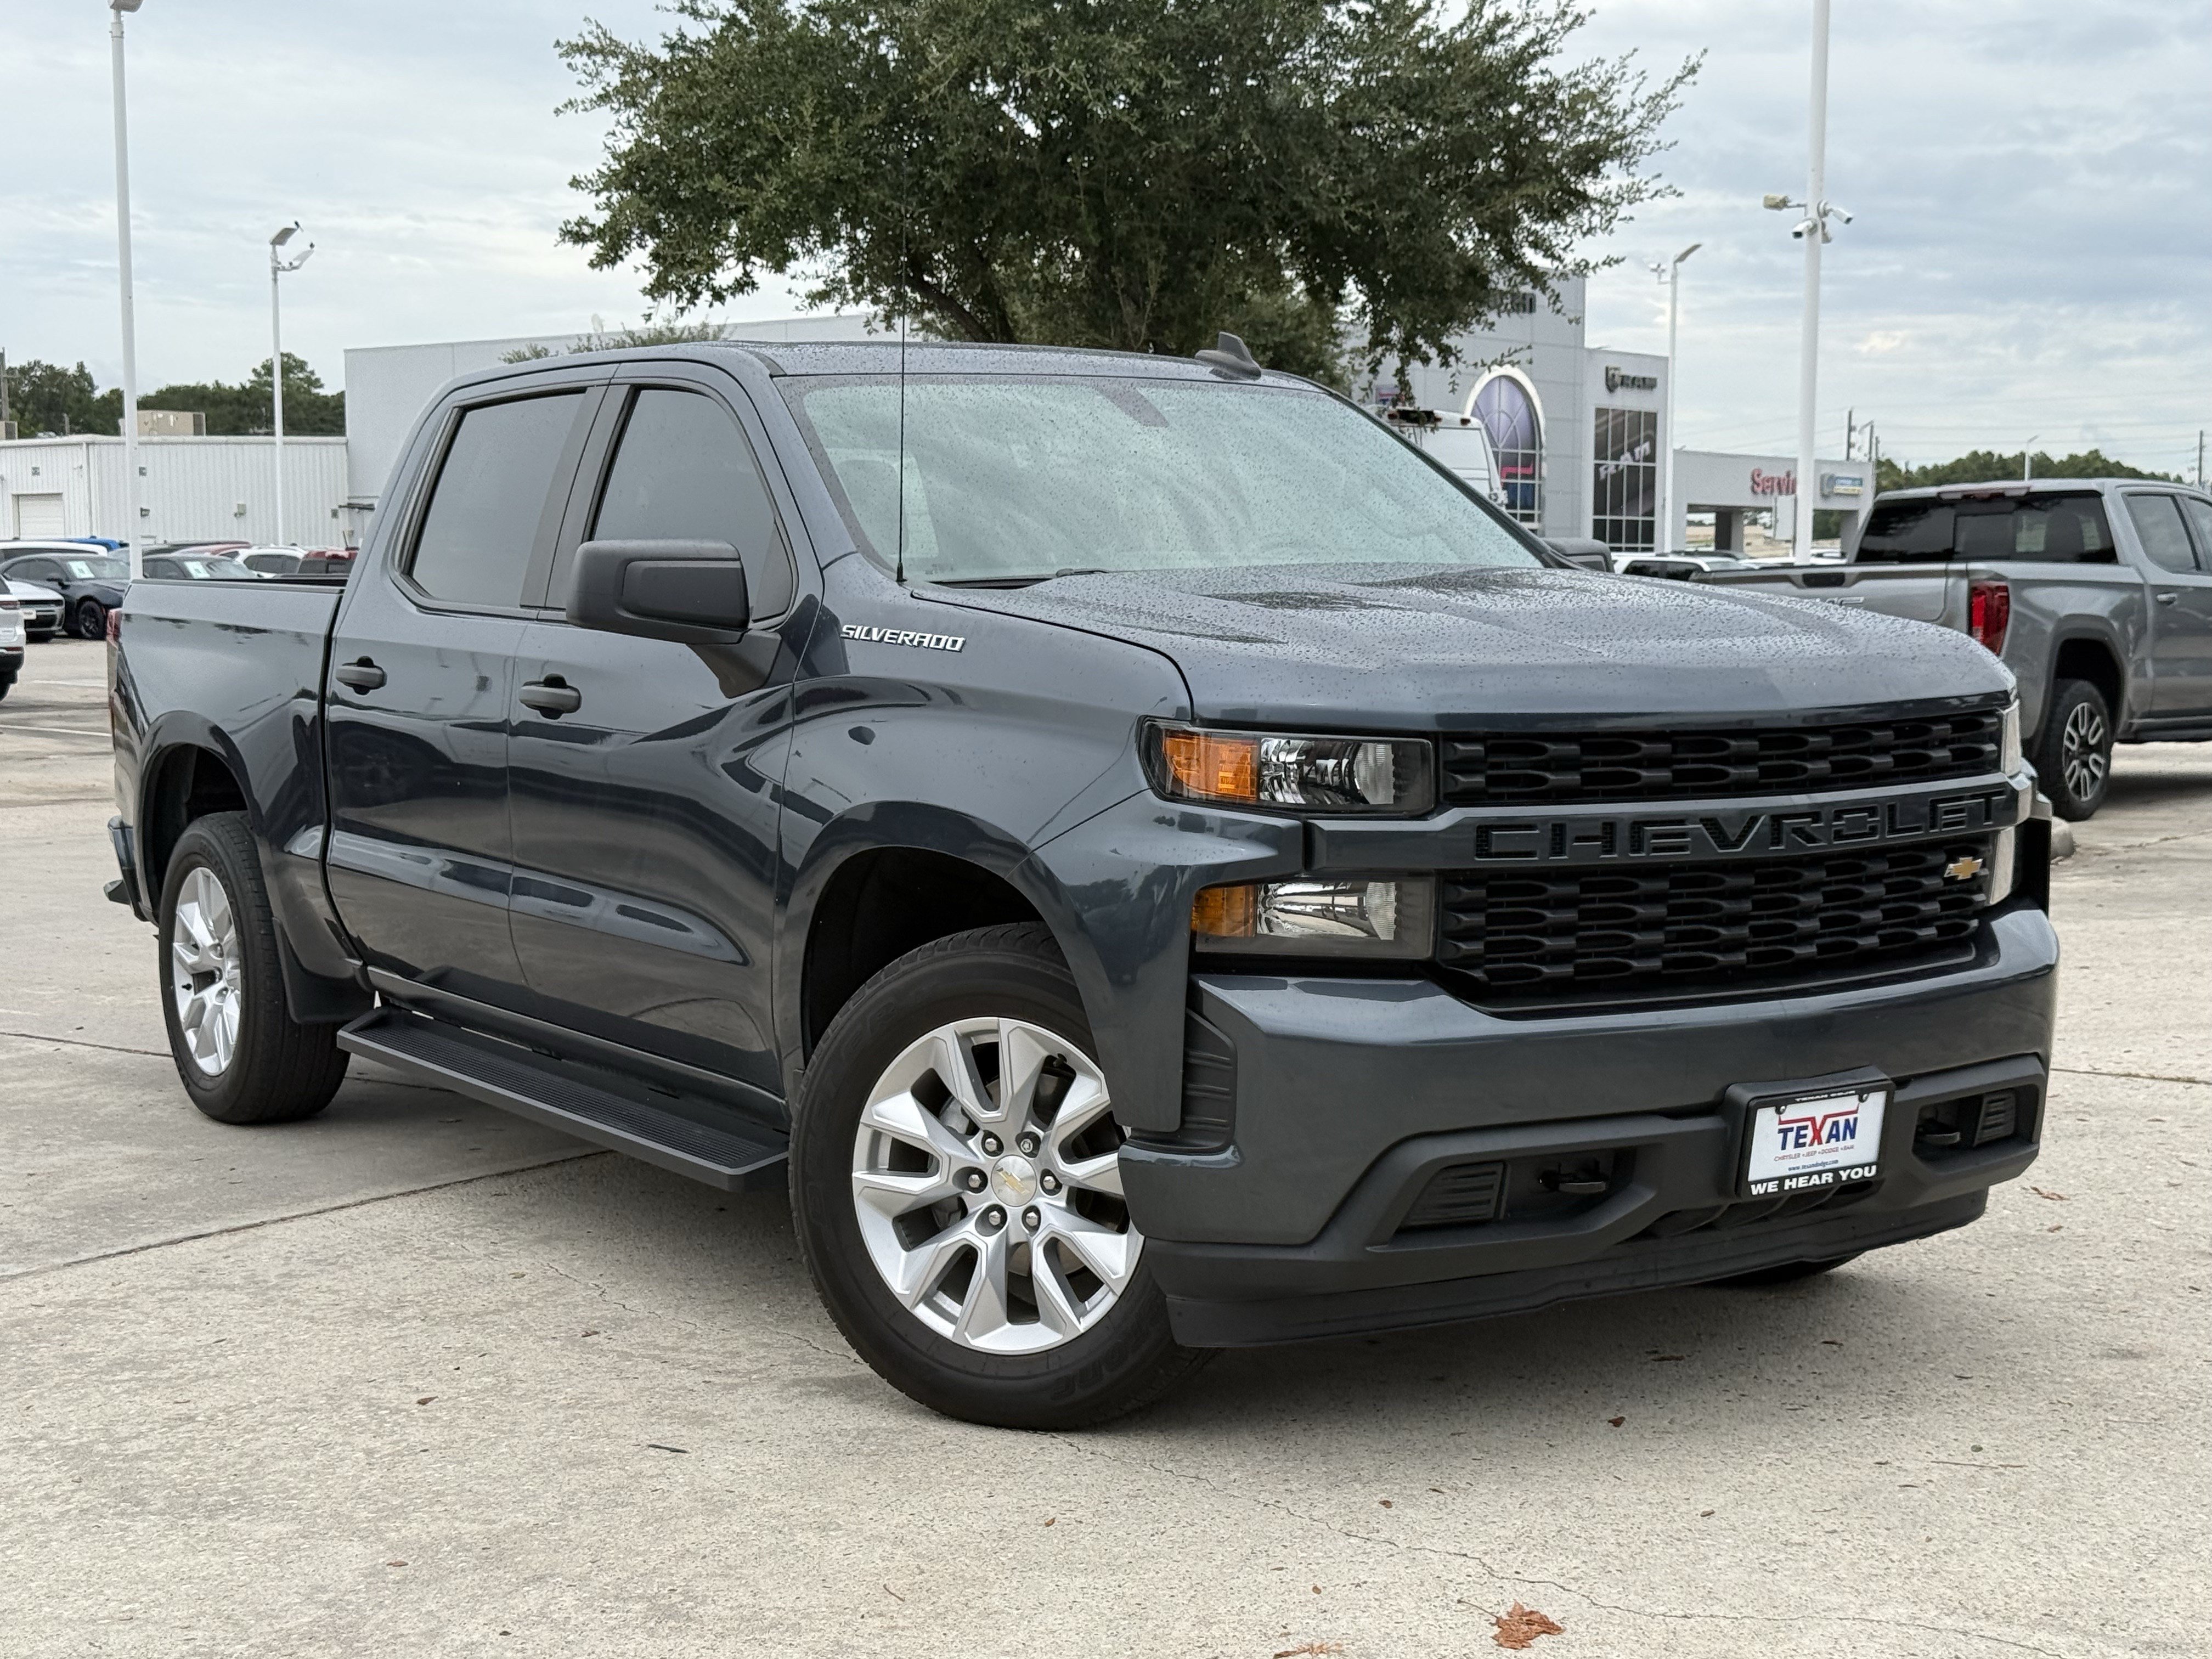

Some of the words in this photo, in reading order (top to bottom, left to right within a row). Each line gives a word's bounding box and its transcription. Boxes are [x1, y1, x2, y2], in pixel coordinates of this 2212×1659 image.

[1751, 468, 1796, 495] Servi
[840, 624, 966, 652] SILVERADO
[1474, 789, 2007, 861] CHEVROLET
[1777, 1111, 1859, 1151] TEXAN
[1774, 1153, 1801, 1162] CHRYSLER
[1750, 1180, 1779, 1196] WE
[1784, 1171, 1835, 1191] HEAR
[1838, 1165, 1877, 1181] YOU
